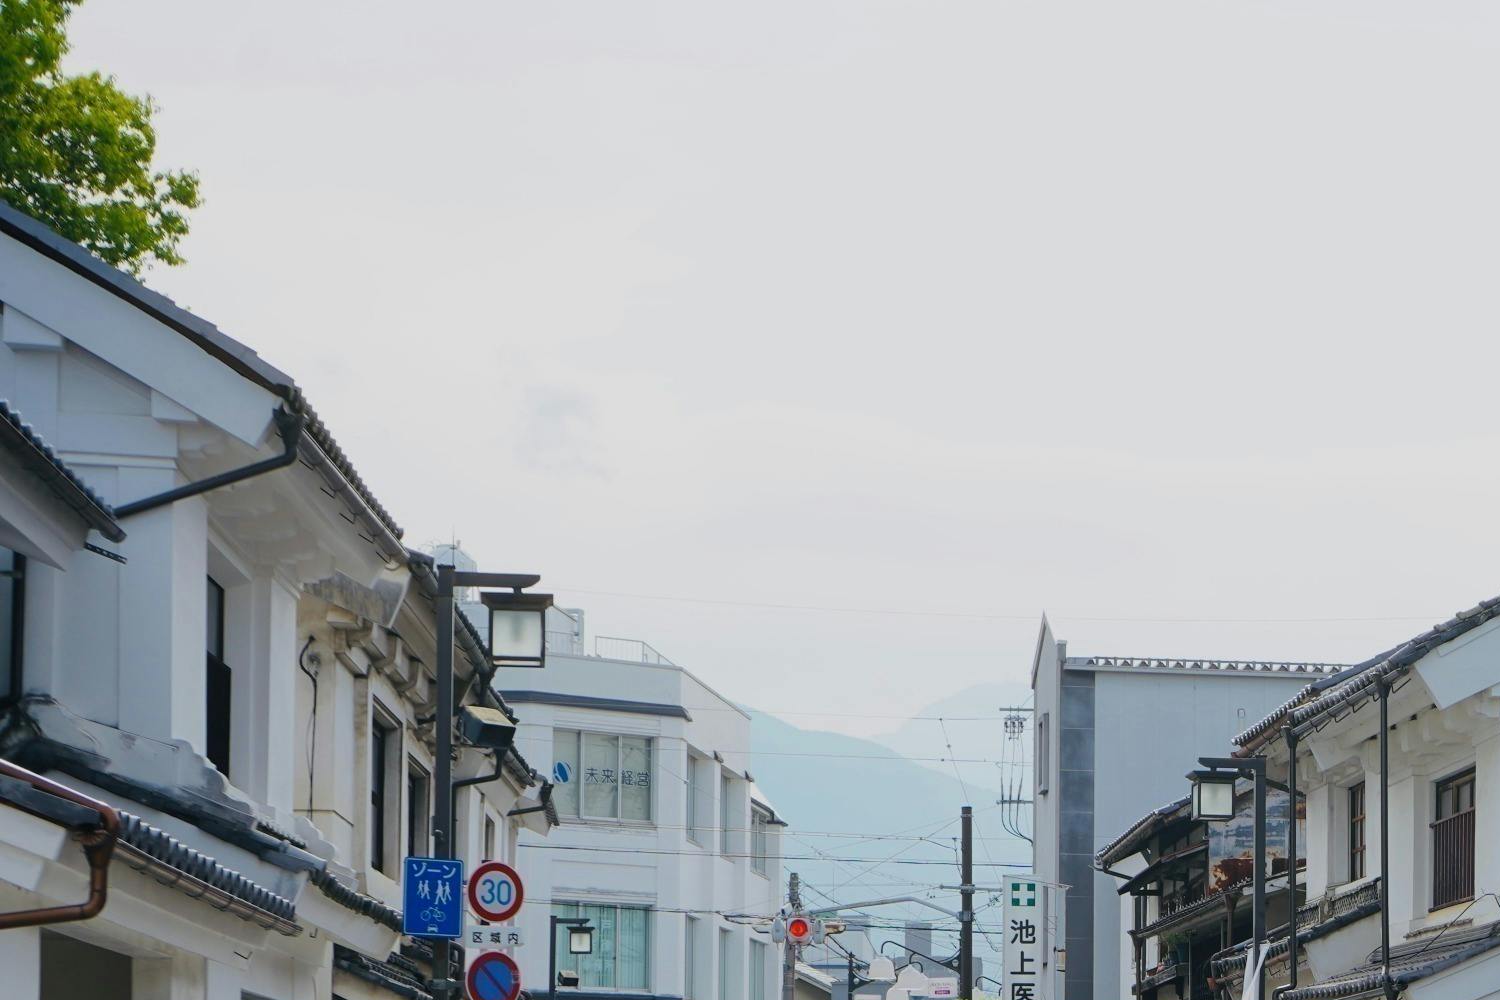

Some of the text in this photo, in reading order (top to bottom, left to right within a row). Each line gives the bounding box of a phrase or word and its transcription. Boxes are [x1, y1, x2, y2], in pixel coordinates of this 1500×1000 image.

[585, 767, 649, 787] 未来経営
[413, 862, 456, 879] ゾーン
[481, 878, 511, 906] 30
[472, 931, 519, 945] 区域内
